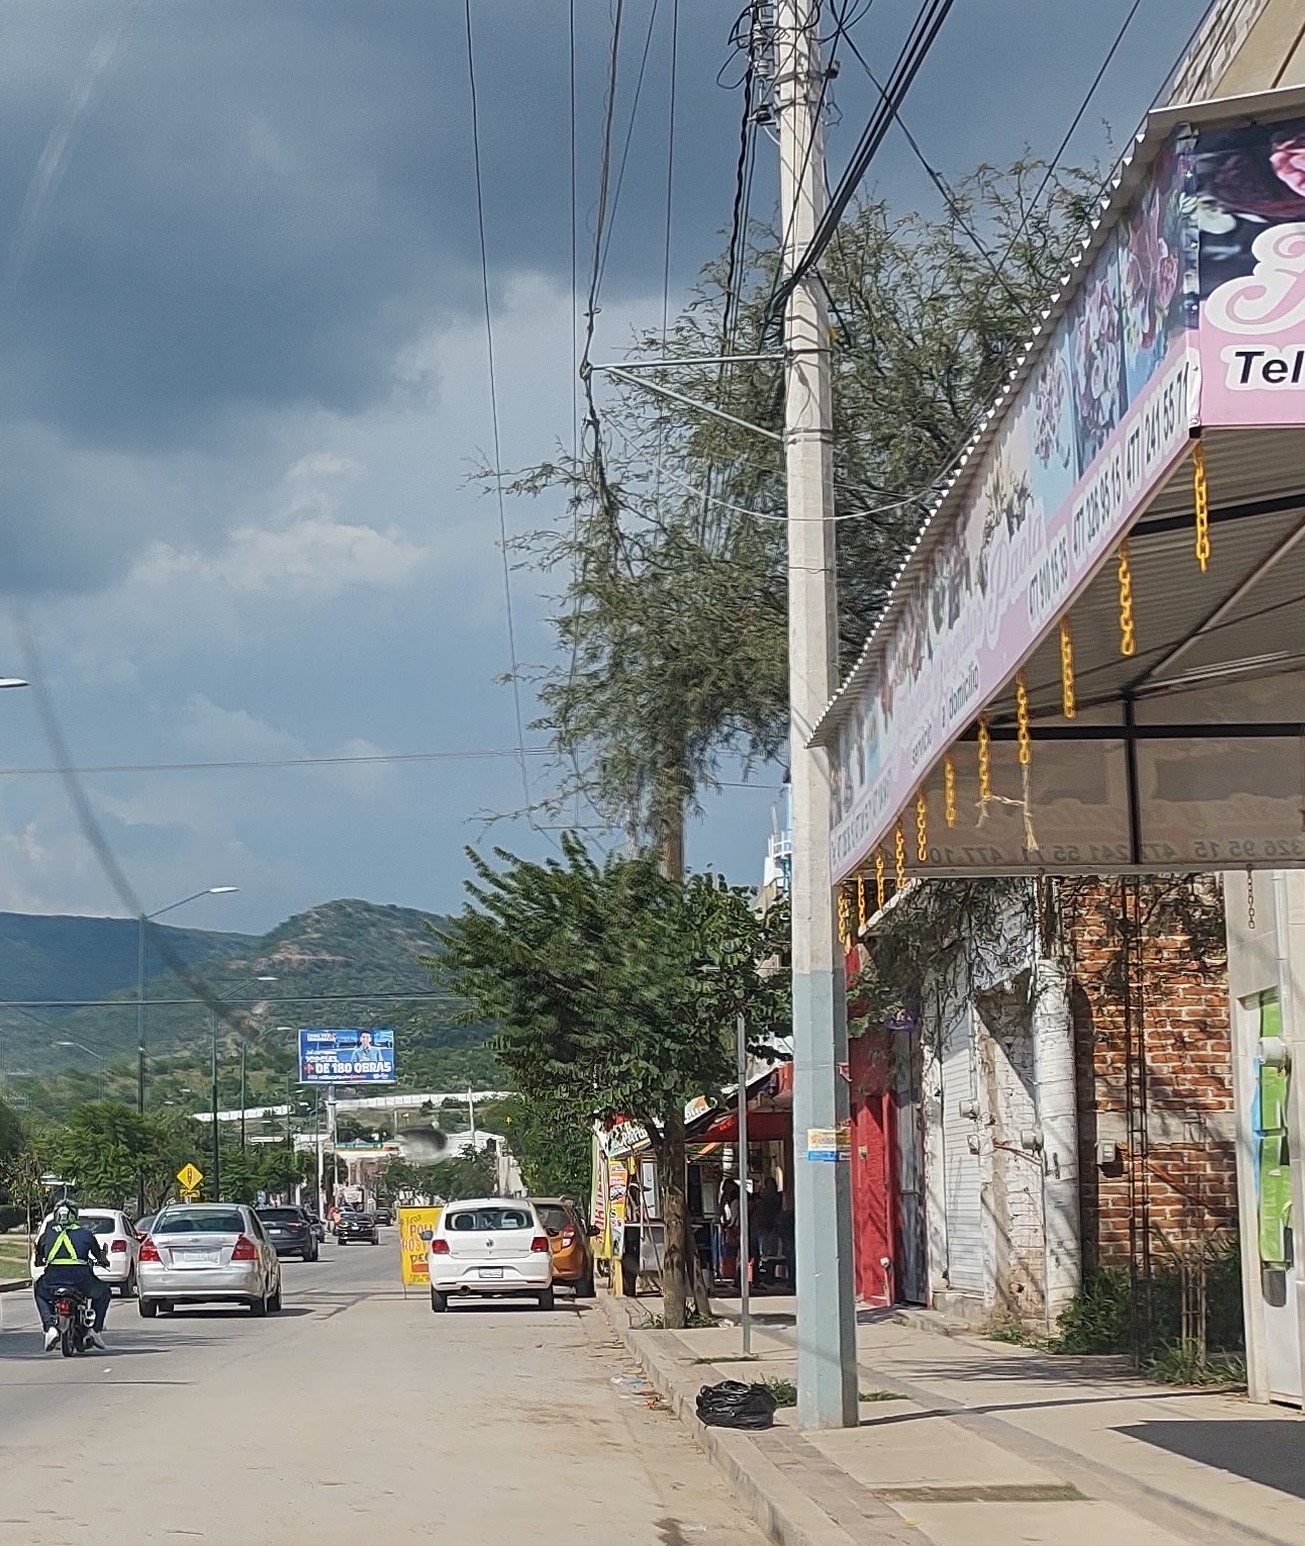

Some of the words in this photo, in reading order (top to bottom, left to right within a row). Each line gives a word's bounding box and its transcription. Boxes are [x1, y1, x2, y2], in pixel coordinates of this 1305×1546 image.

[1127, 425, 1140, 488] 477
[1145, 397, 1161, 465] 241
[1163, 381, 1175, 441] 55
[1177, 361, 1190, 425] 71
[1074, 504, 1084, 560] 477
[1111, 455, 1122, 509] 15
[315, 1062, 330, 1074] DE
[354, 1061, 392, 1074] OBRAS
